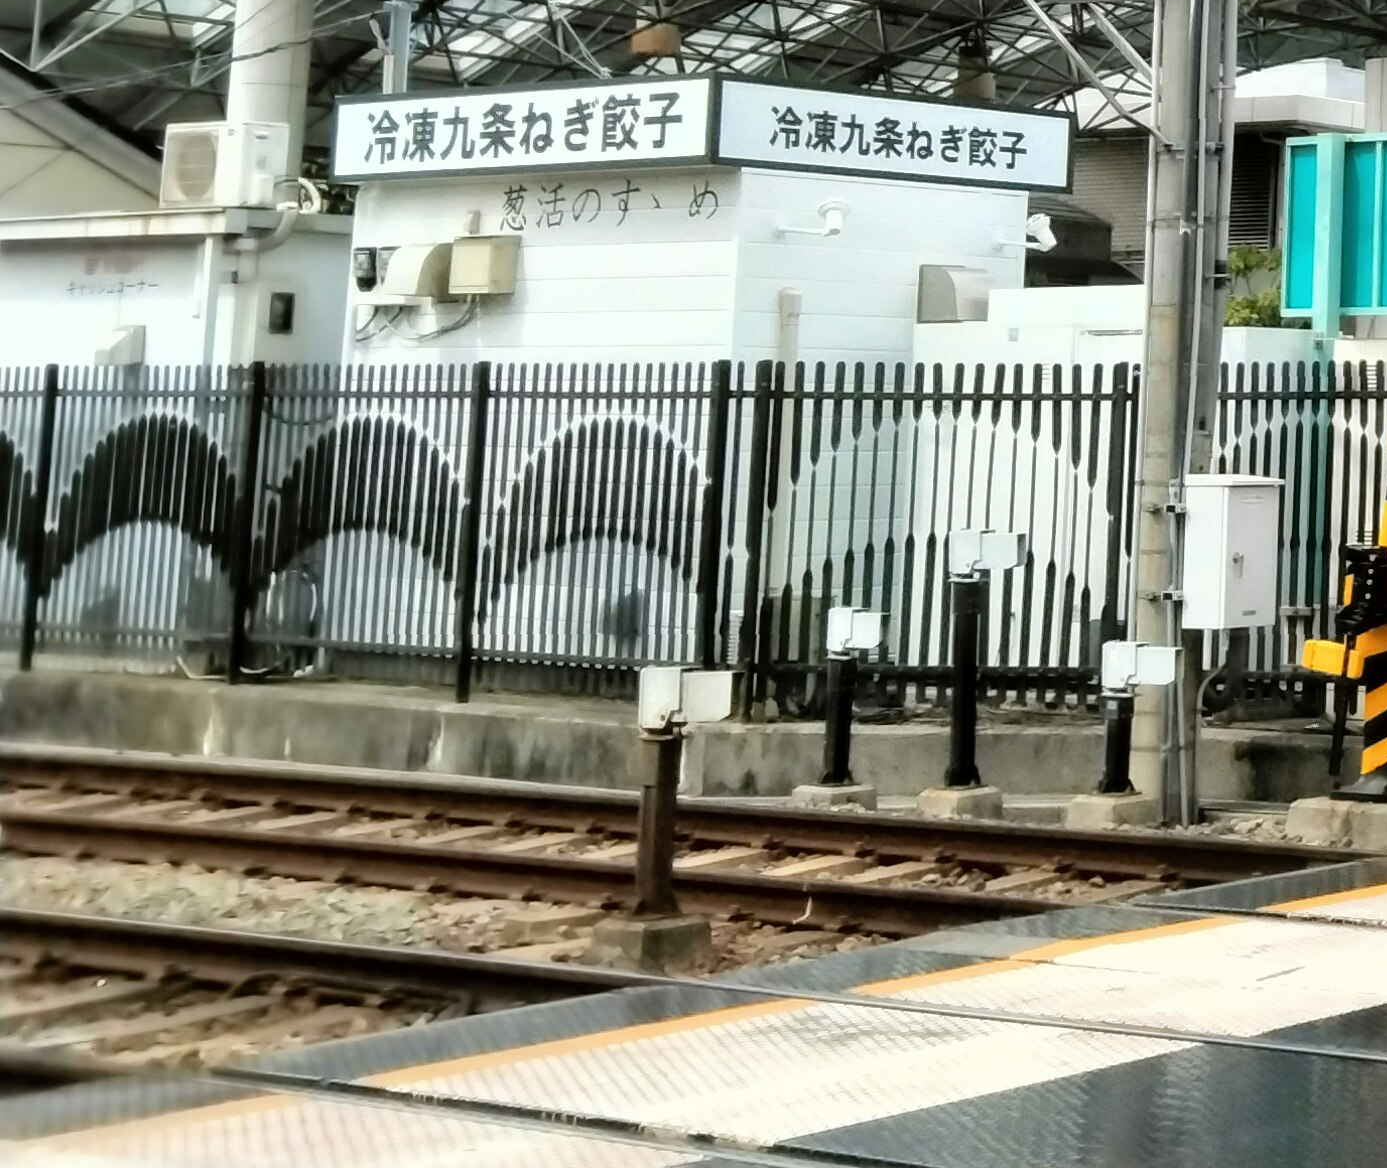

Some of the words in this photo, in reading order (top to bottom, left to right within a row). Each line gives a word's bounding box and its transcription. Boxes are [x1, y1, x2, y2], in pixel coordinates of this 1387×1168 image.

[363, 91, 684, 164] 冷凍九条ねぎ餃子
[769, 105, 1029, 171] 冷凍九条ねぎ餃子
